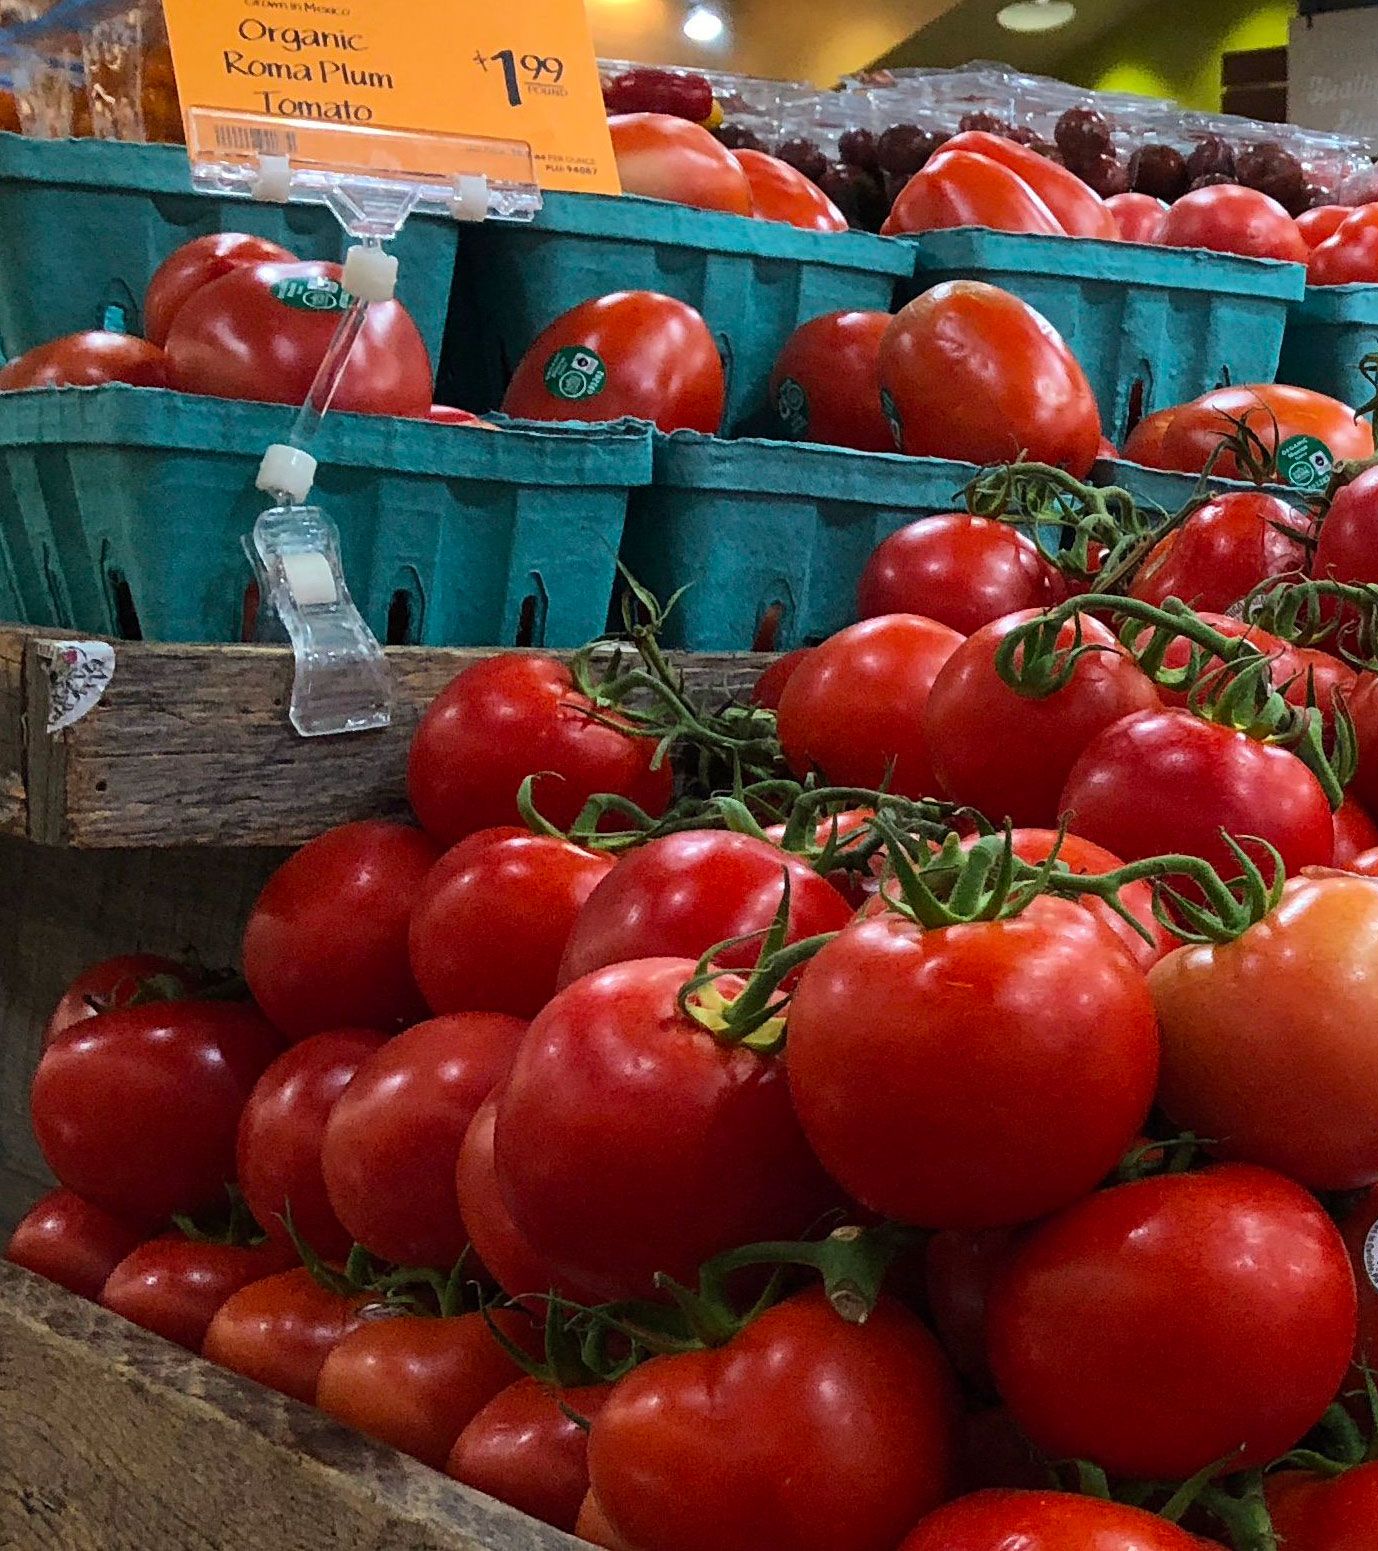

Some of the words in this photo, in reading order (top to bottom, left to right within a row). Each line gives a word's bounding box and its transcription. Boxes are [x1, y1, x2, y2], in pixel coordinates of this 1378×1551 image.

[239, 18, 369, 51] Organic
[223, 50, 312, 81] Roma
[319, 61, 394, 89] Plum
[253, 90, 373, 121] Tomato
